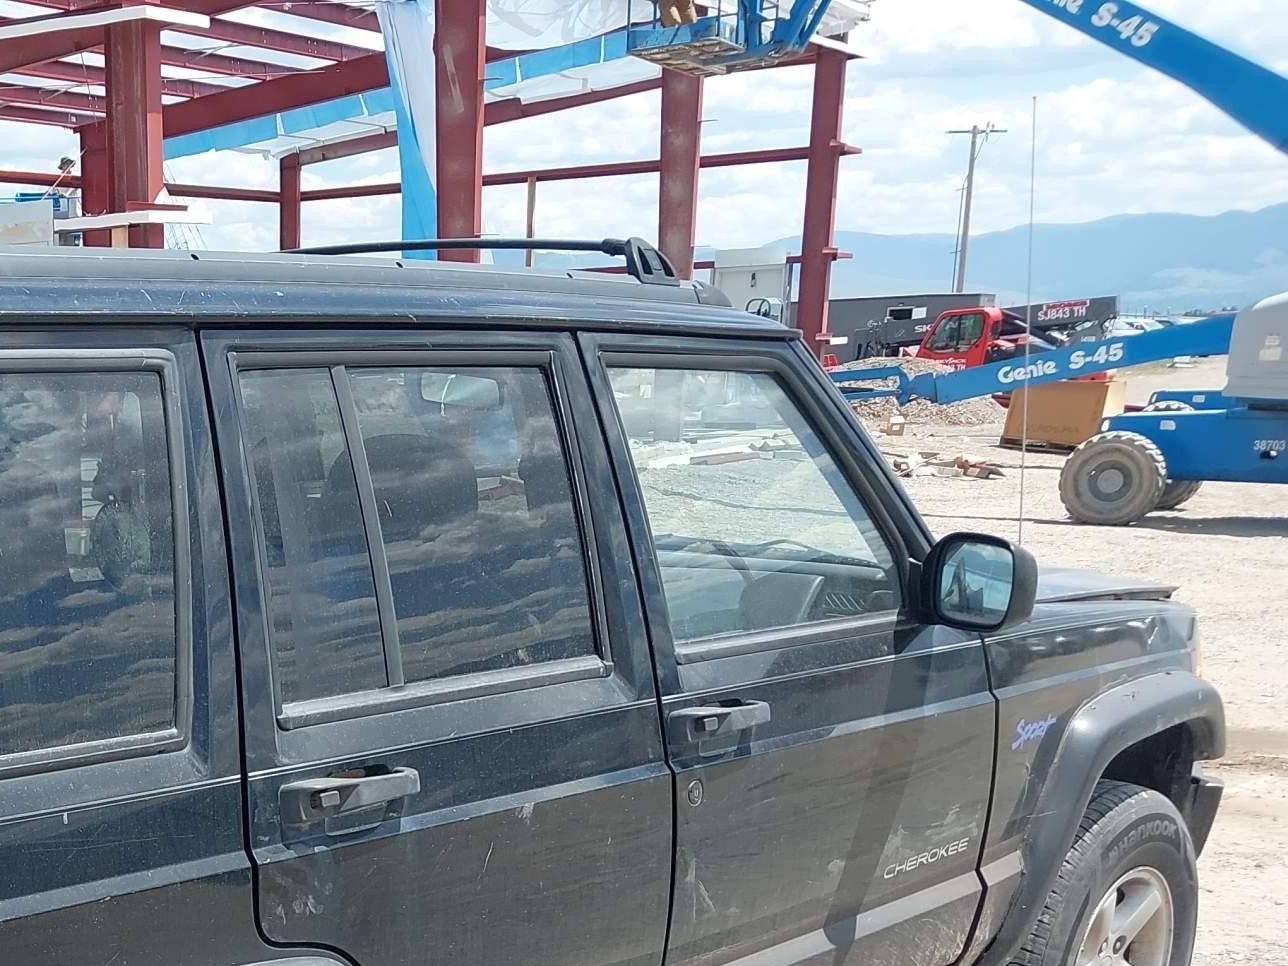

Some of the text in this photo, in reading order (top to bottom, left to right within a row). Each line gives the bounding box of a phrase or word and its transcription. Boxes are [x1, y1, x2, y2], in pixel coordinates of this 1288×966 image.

[1091, 2, 1160, 47] S-45
[1037, 306, 1086, 320] SJ843 TH
[998, 343, 1123, 383] Genie S-45
[1253, 440, 1286, 451] 38703
[884, 838, 969, 879] CHEROKEE
